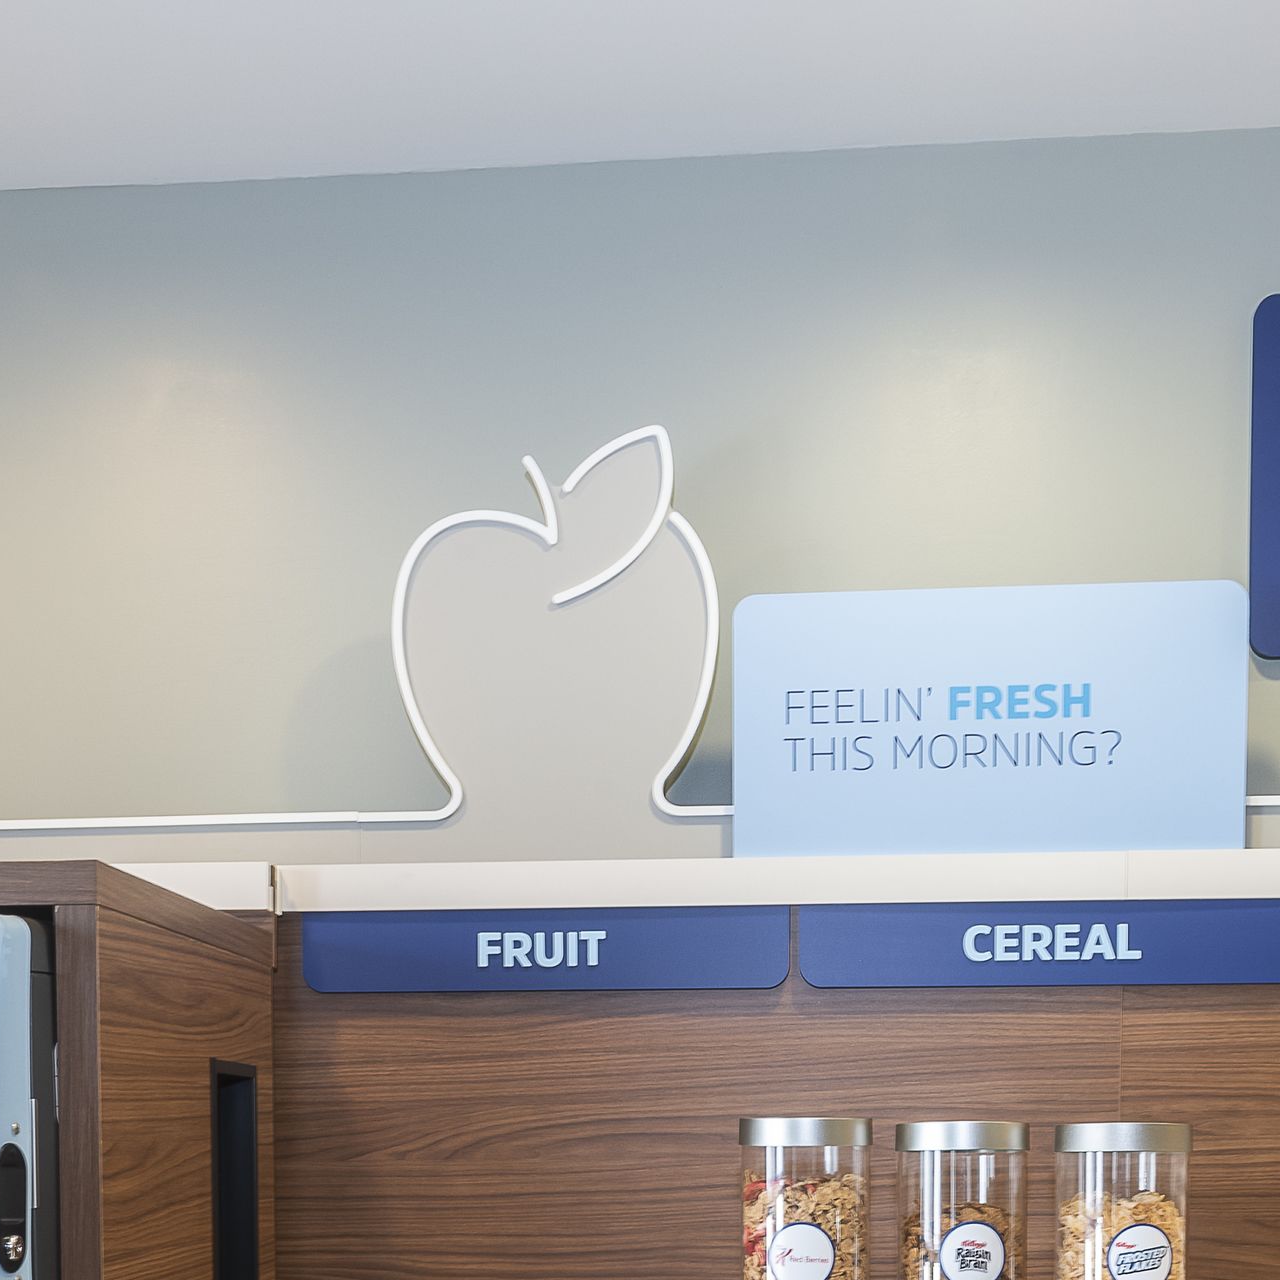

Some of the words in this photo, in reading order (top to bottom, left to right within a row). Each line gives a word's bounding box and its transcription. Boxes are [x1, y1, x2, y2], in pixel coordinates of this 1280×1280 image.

[948, 682, 1092, 722] FRESH
[784, 734, 875, 773] THIS
[891, 728, 1123, 770] MORNING?
[475, 929, 607, 969] FRUIT
[961, 923, 1144, 963] CEREAL
[955, 1247, 992, 1261] Raisin
[958, 1258, 988, 1271] Bran
[1116, 1246, 1168, 1266] FROSTED
[1117, 1259, 1162, 1276] FLAKES
